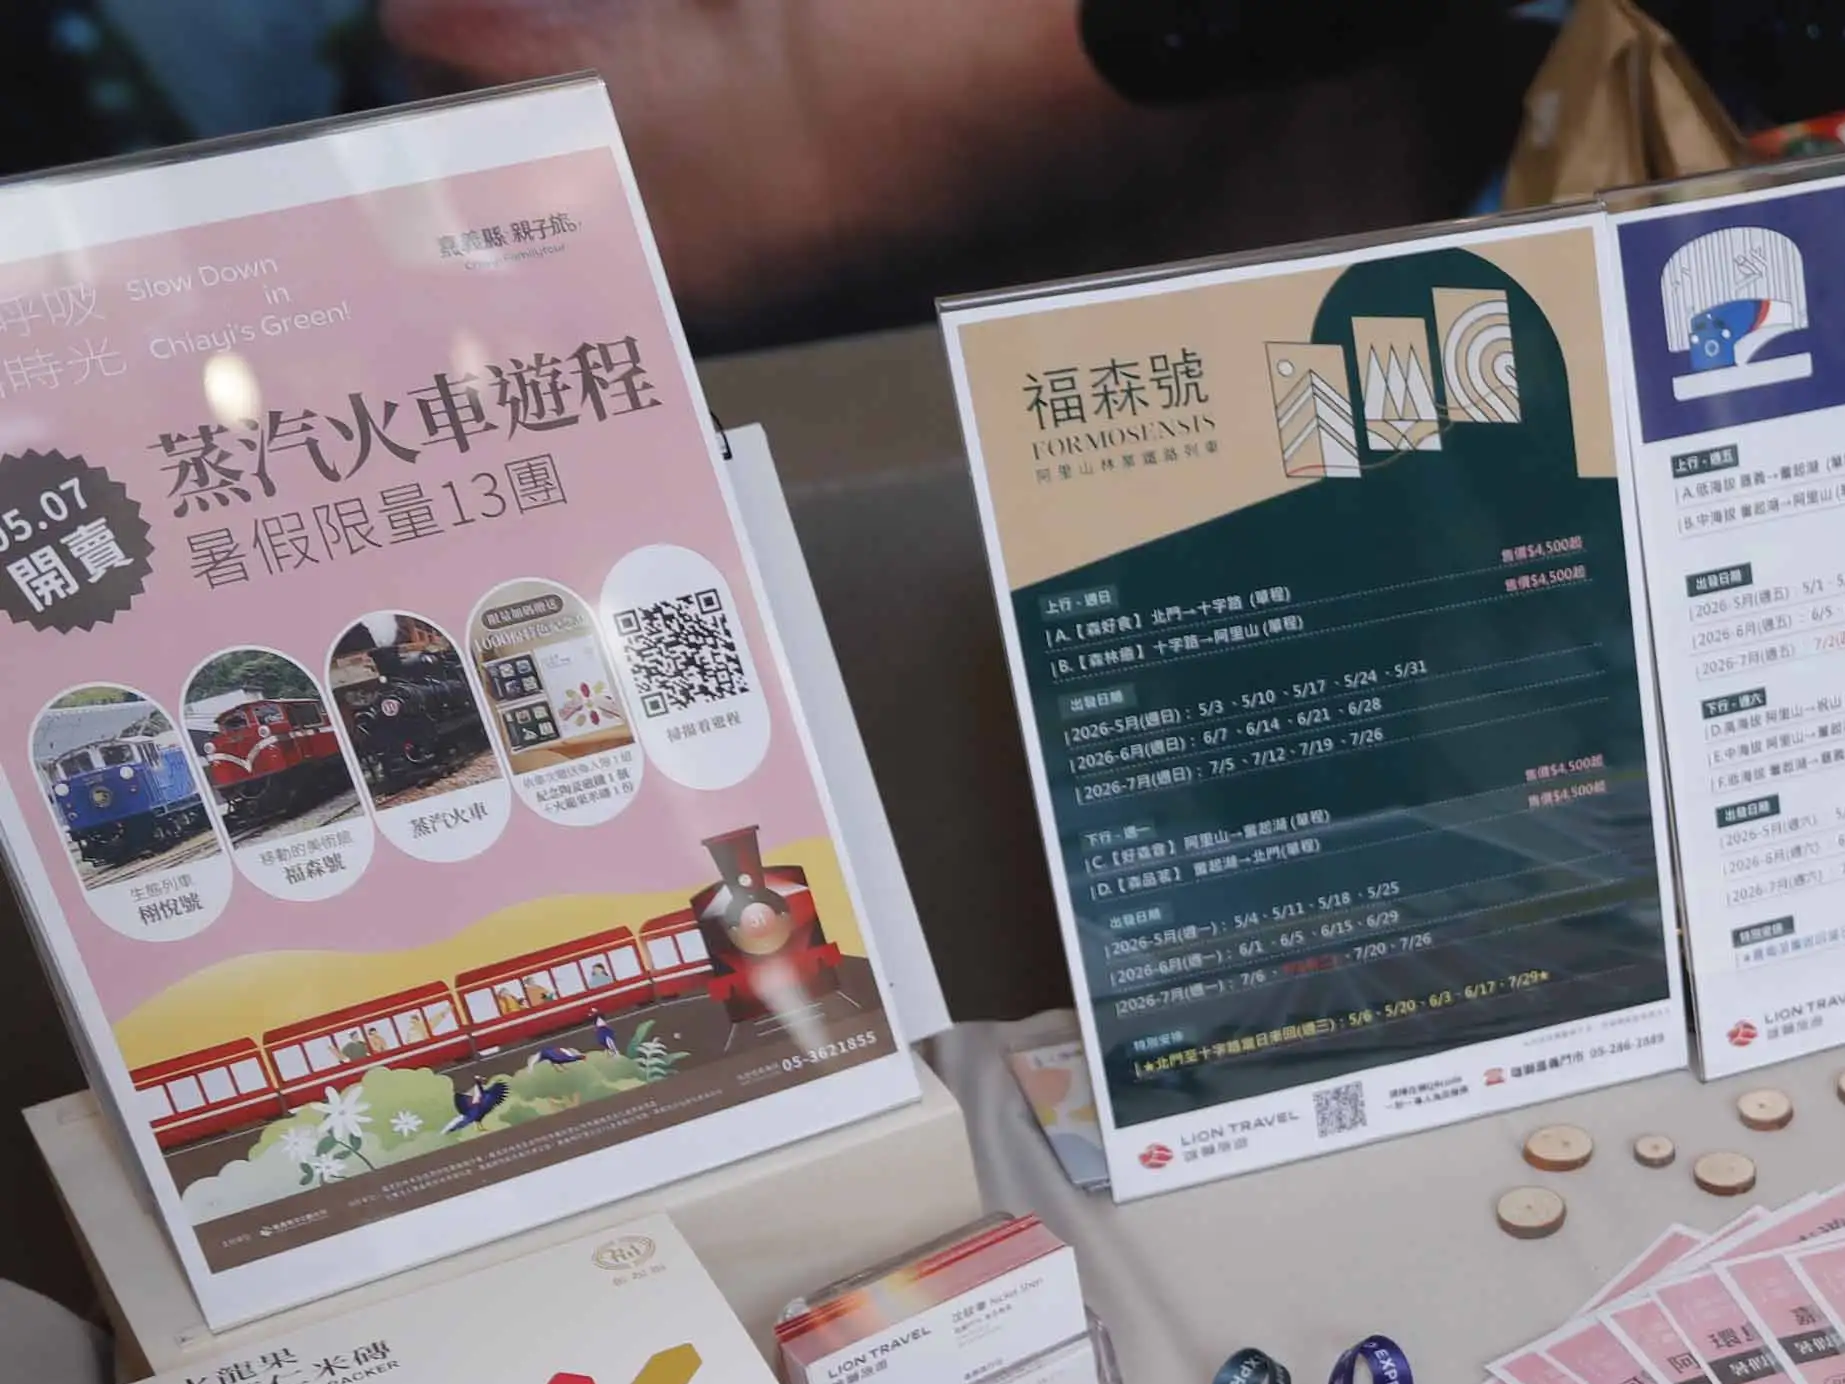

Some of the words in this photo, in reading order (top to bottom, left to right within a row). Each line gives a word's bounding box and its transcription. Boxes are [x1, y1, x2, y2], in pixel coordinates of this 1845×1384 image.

[126, 276, 193, 302] Slow
[198, 256, 279, 288] Down
[263, 284, 292, 305] in
[149, 323, 256, 360] Chiayi's
[260, 300, 352, 338] Green!
[1023, 345, 1212, 433] 福森號
[147, 335, 663, 519] 蒸汽火車遊程
[1033, 415, 1218, 462] FORMOSENSIS
[186, 452, 568, 590] 暑假限量13團
[6, 516, 135, 613] 開賣
[409, 801, 489, 840] 蒸汽火車
[781, 1030, 878, 1073] 05-3621855
[1182, 1126, 1226, 1147] LION
[1229, 1107, 1301, 1135] TRAVEL
[827, 1353, 868, 1379] LION
[870, 1325, 932, 1358] TRAVEL
